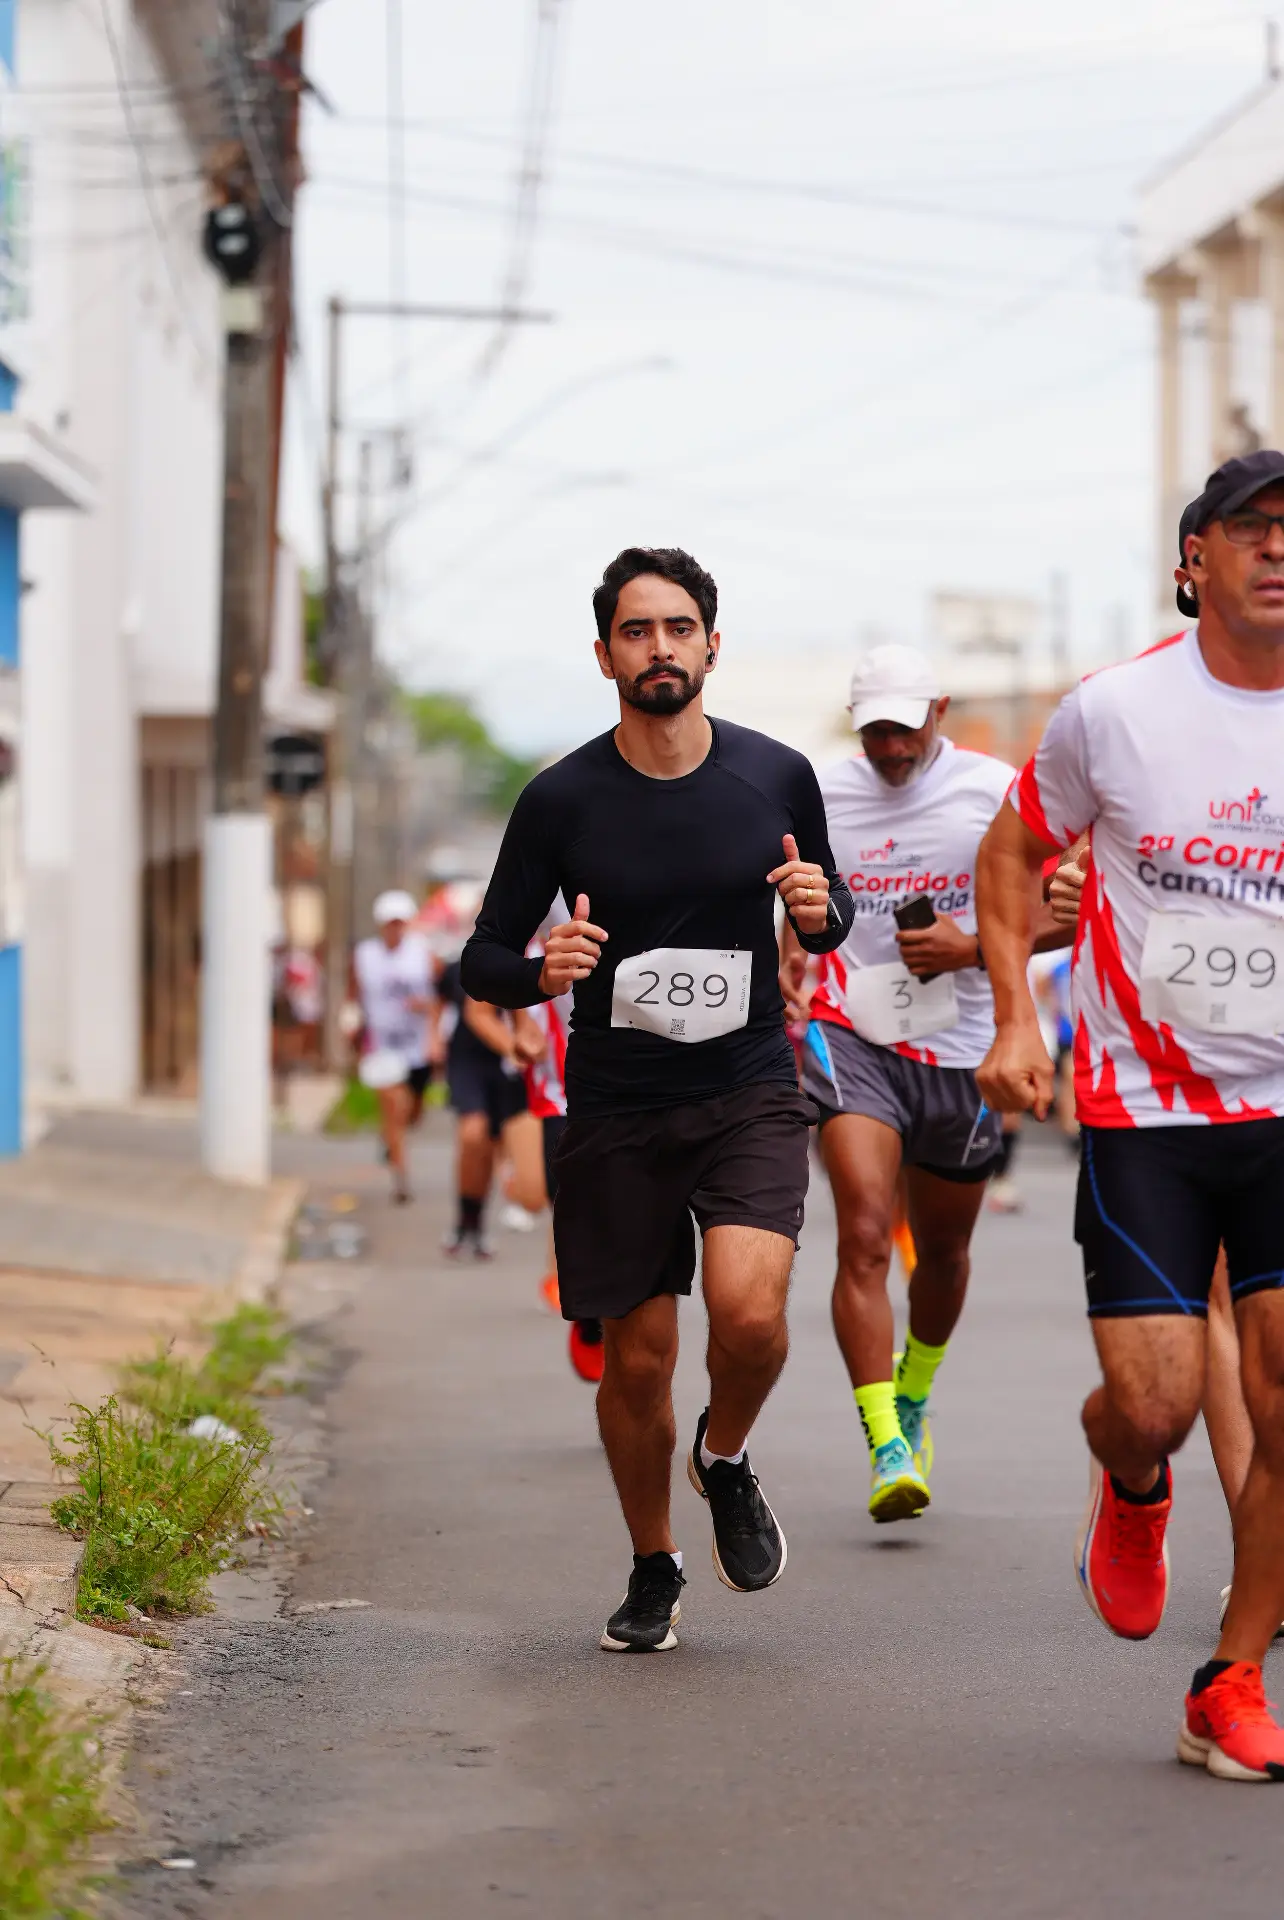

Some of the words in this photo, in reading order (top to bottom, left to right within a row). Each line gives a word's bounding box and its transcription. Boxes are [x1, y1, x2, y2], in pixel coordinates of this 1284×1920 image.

[955, 872, 971, 888] e
[1167, 943, 1276, 989] 299
[633, 970, 729, 1009] 289
[891, 980, 913, 1009] 3
